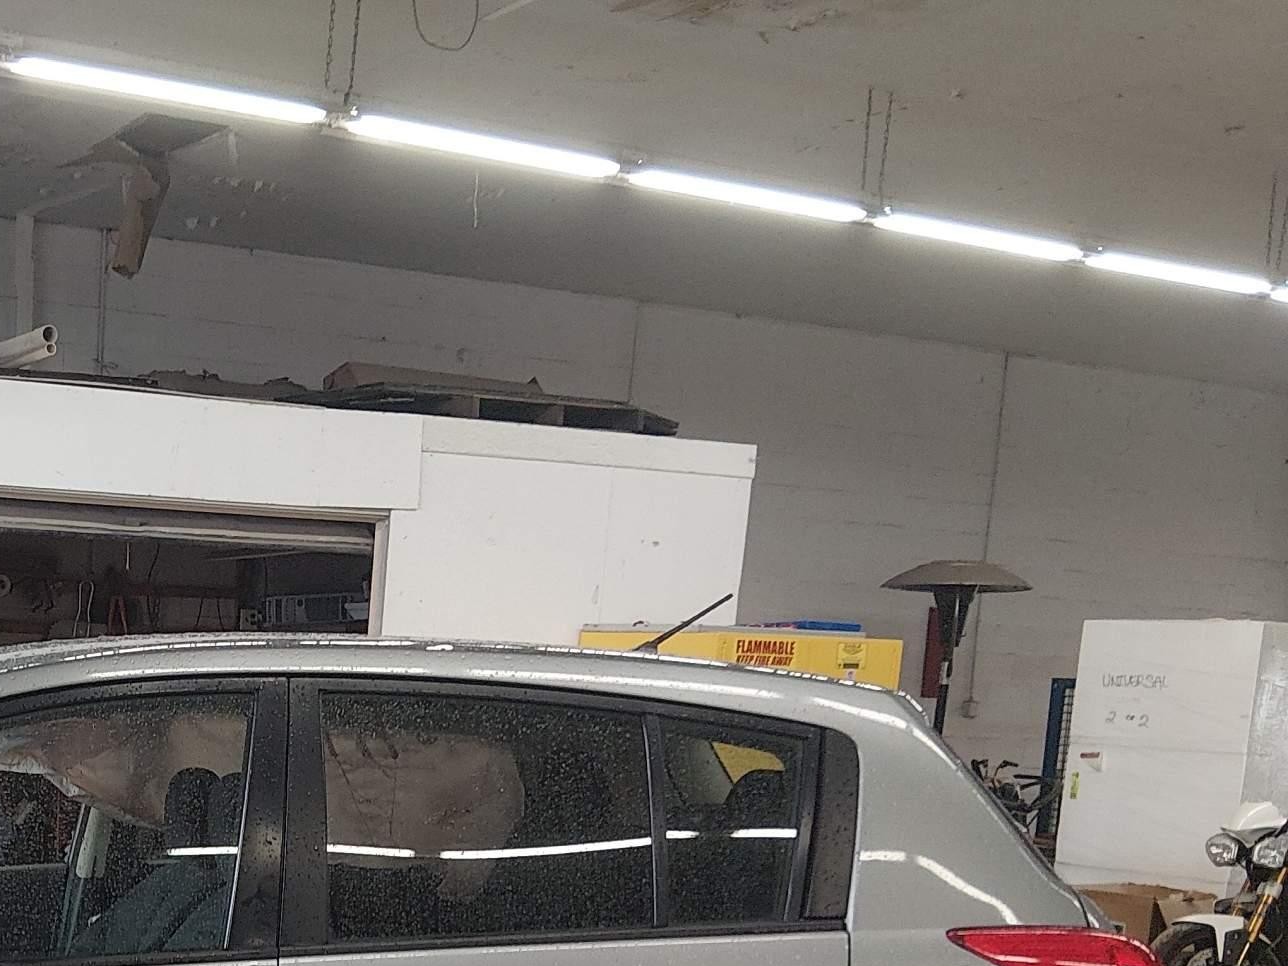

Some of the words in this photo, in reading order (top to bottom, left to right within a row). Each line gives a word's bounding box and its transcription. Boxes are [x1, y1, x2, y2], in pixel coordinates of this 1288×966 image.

[736, 639, 796, 655] FLAMMABLE
[771, 656, 793, 667] AWAY
[1102, 673, 1169, 690] UNIVERSAL
[1105, 710, 1117, 724] 2
[1137, 714, 1150, 728] 2
